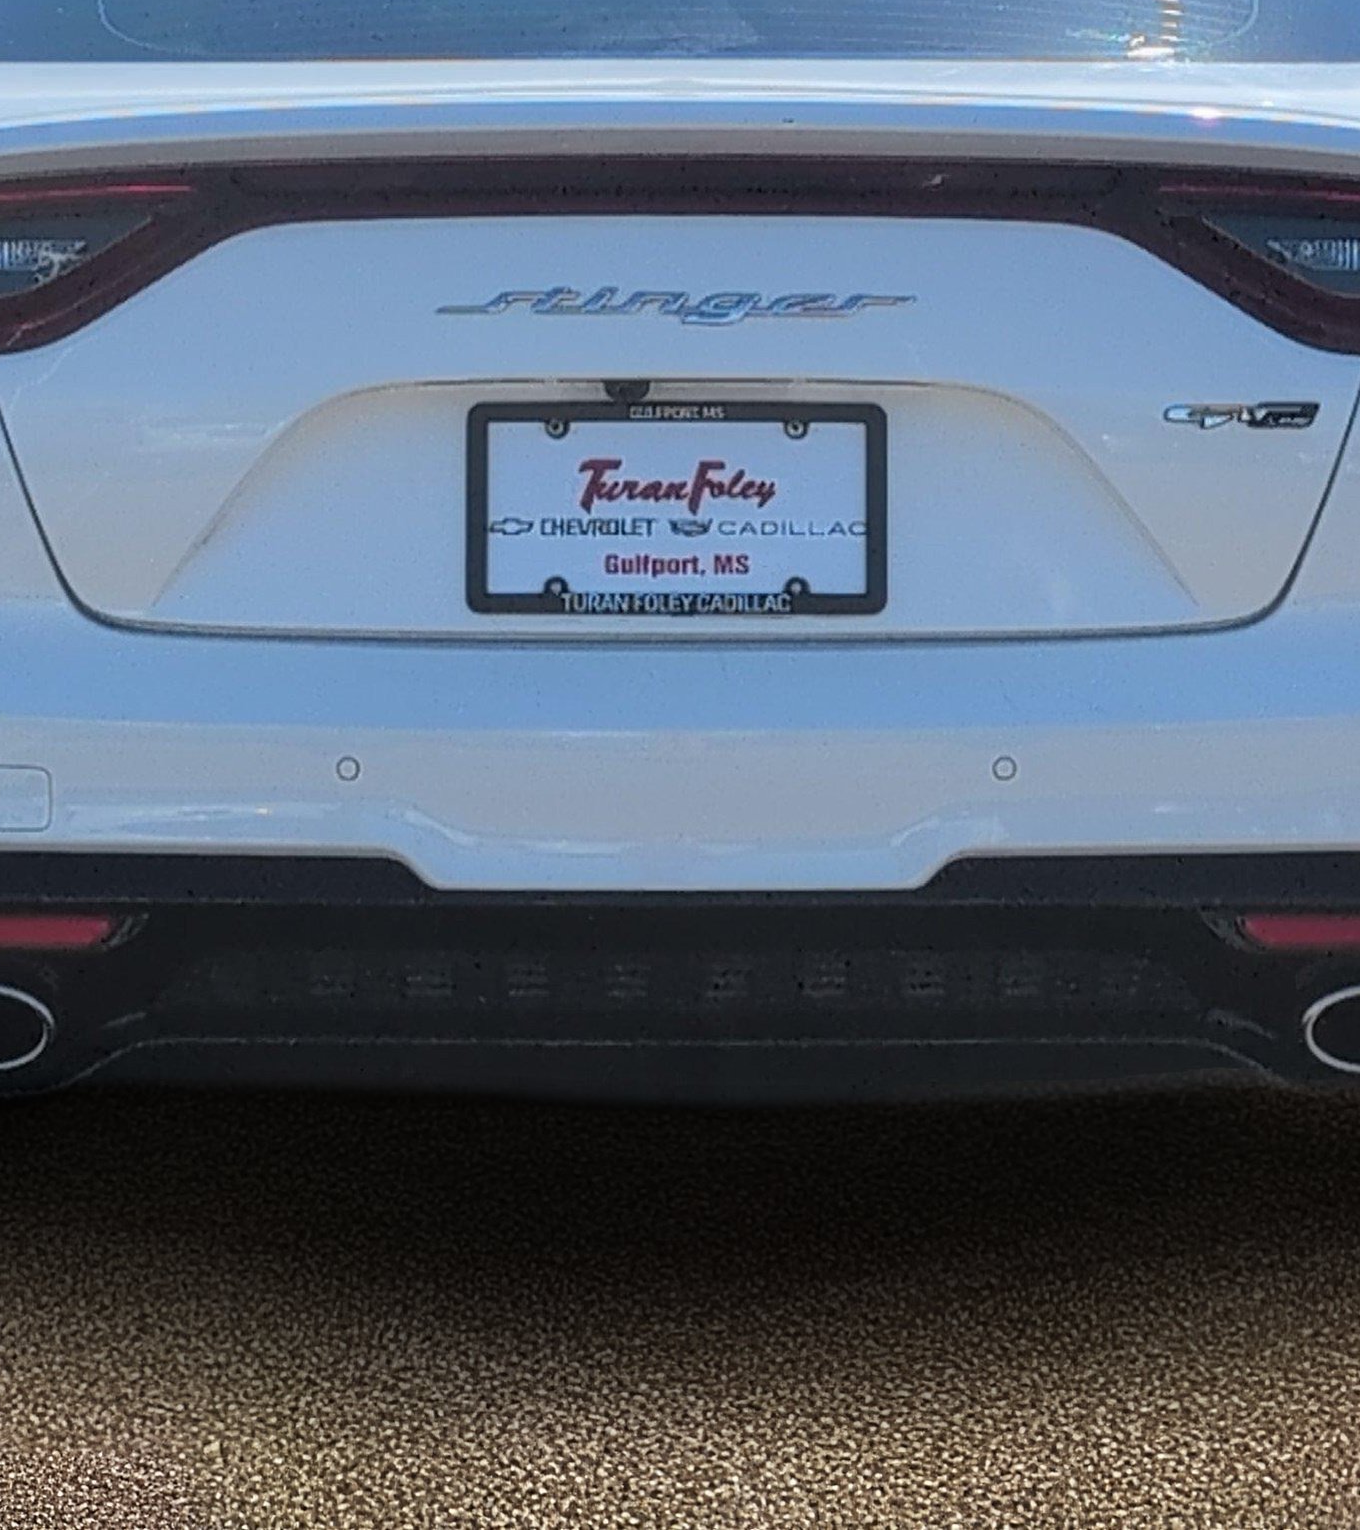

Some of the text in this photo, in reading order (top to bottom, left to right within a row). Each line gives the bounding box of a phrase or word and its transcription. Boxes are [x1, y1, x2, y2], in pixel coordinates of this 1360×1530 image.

[435, 285, 917, 327] stinger
[540, 517, 868, 536] CHEVROLET CADILLAC
[604, 553, 751, 578] Gulfport, MS
[561, 592, 791, 613] TURAN FOLEY CADILLAC
